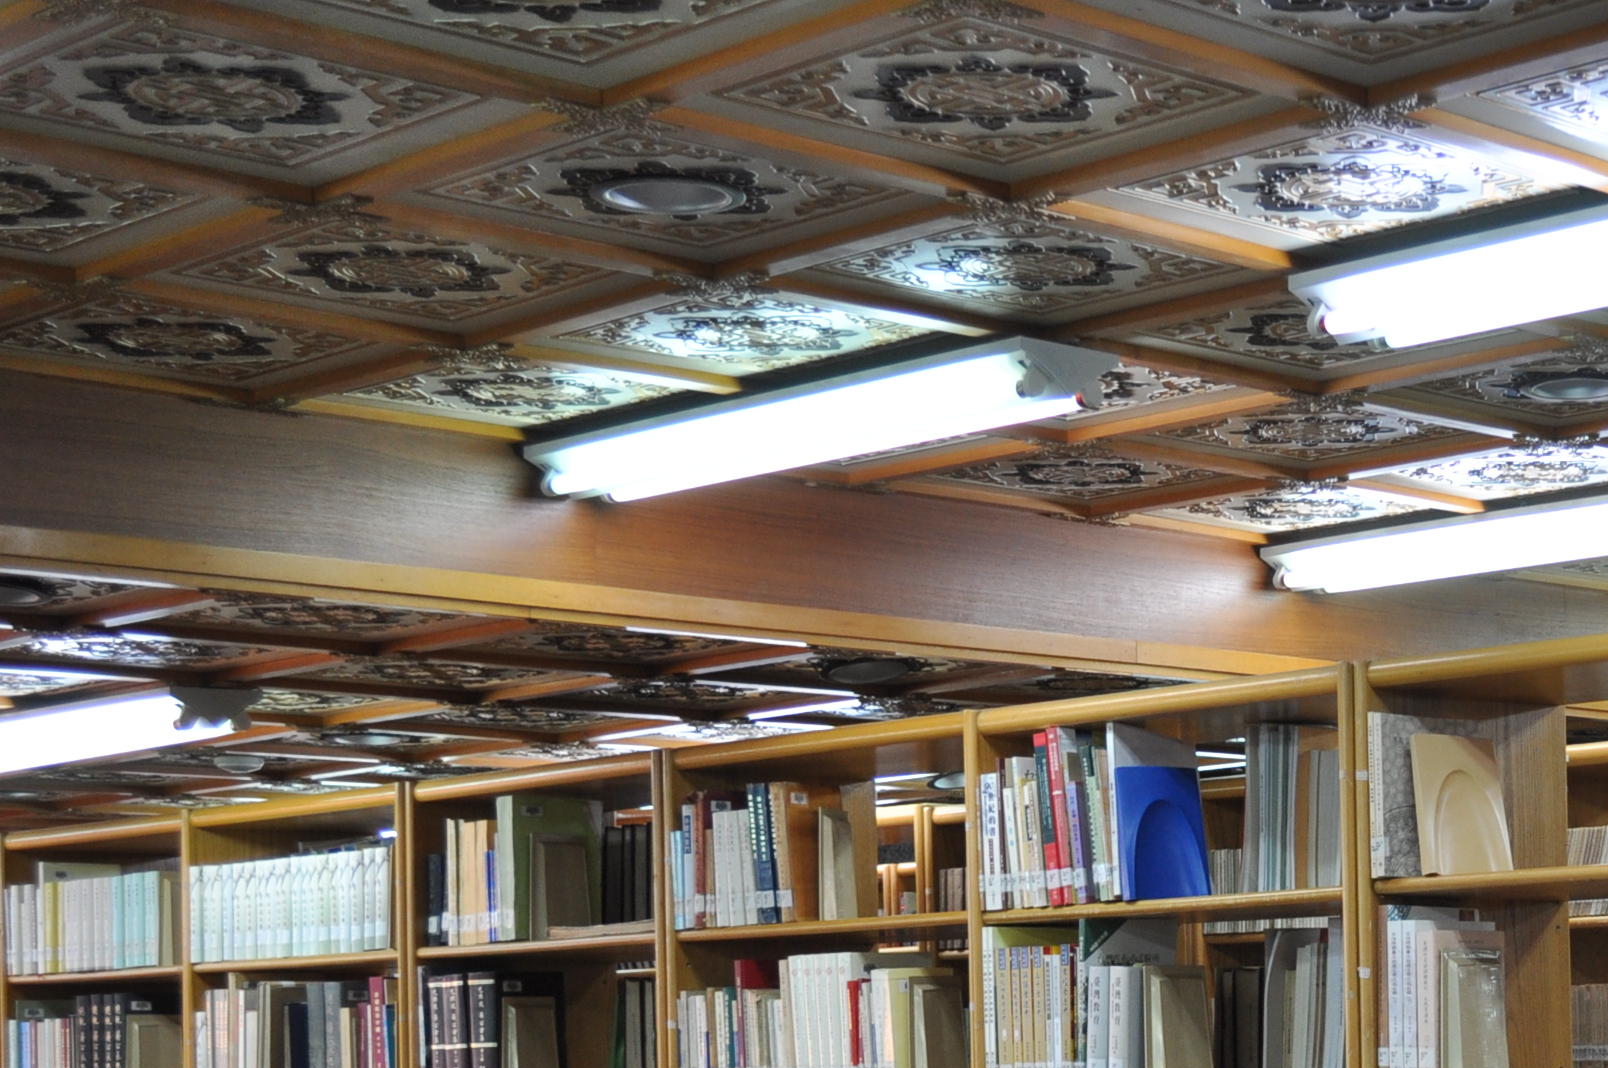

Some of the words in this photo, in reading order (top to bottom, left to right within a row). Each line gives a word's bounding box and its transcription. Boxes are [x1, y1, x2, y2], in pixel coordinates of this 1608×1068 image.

[1093, 976, 1101, 1026] 臺灣教育
[1114, 976, 1122, 1026] 臺灣教育
